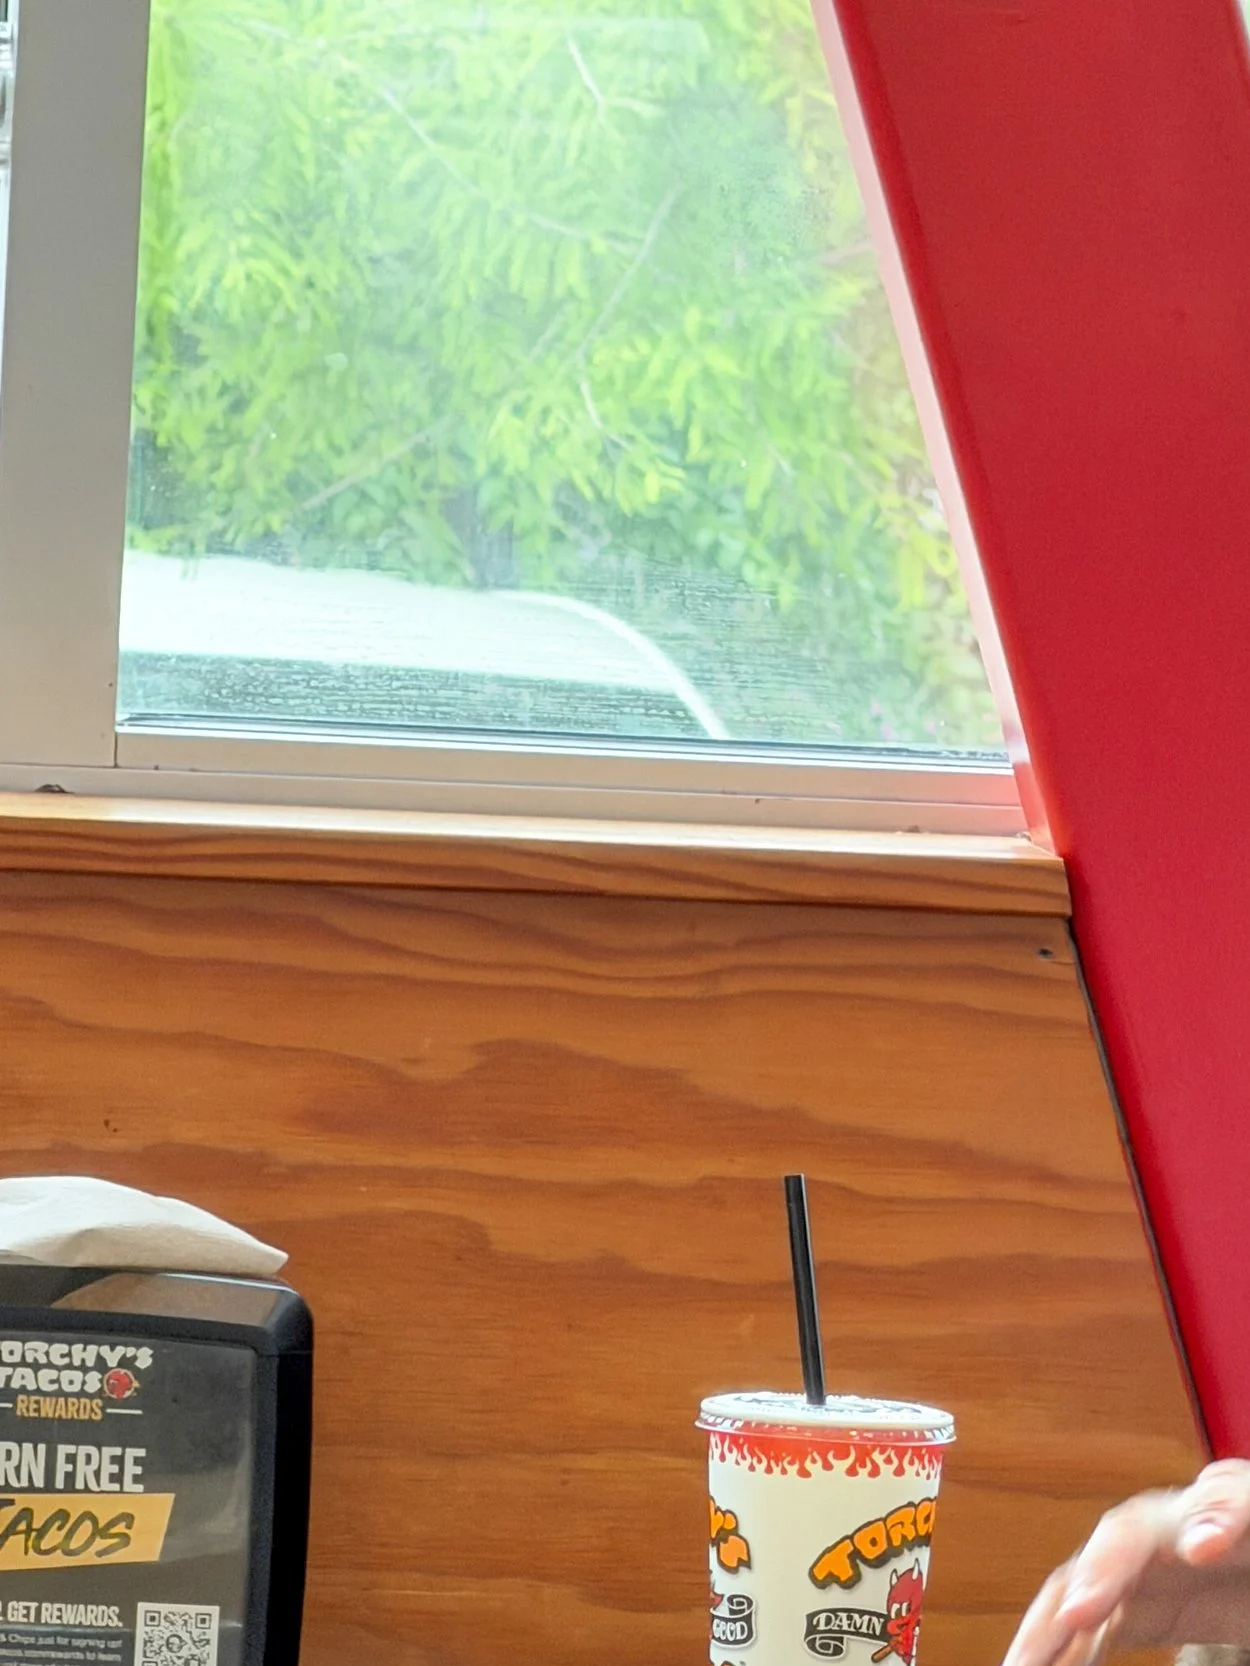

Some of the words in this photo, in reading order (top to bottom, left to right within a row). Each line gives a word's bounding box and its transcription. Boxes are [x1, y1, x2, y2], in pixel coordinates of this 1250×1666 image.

[16, 1394, 103, 1421] REWARDS
[55, 1444, 147, 1492] FREE
[808, 1497, 937, 1590] TORC
[7, 1600, 39, 1623] GET
[41, 1602, 123, 1627] REWARDS.
[812, 1611, 885, 1637] DAMN
[713, 1618, 748, 1642] GOOD
